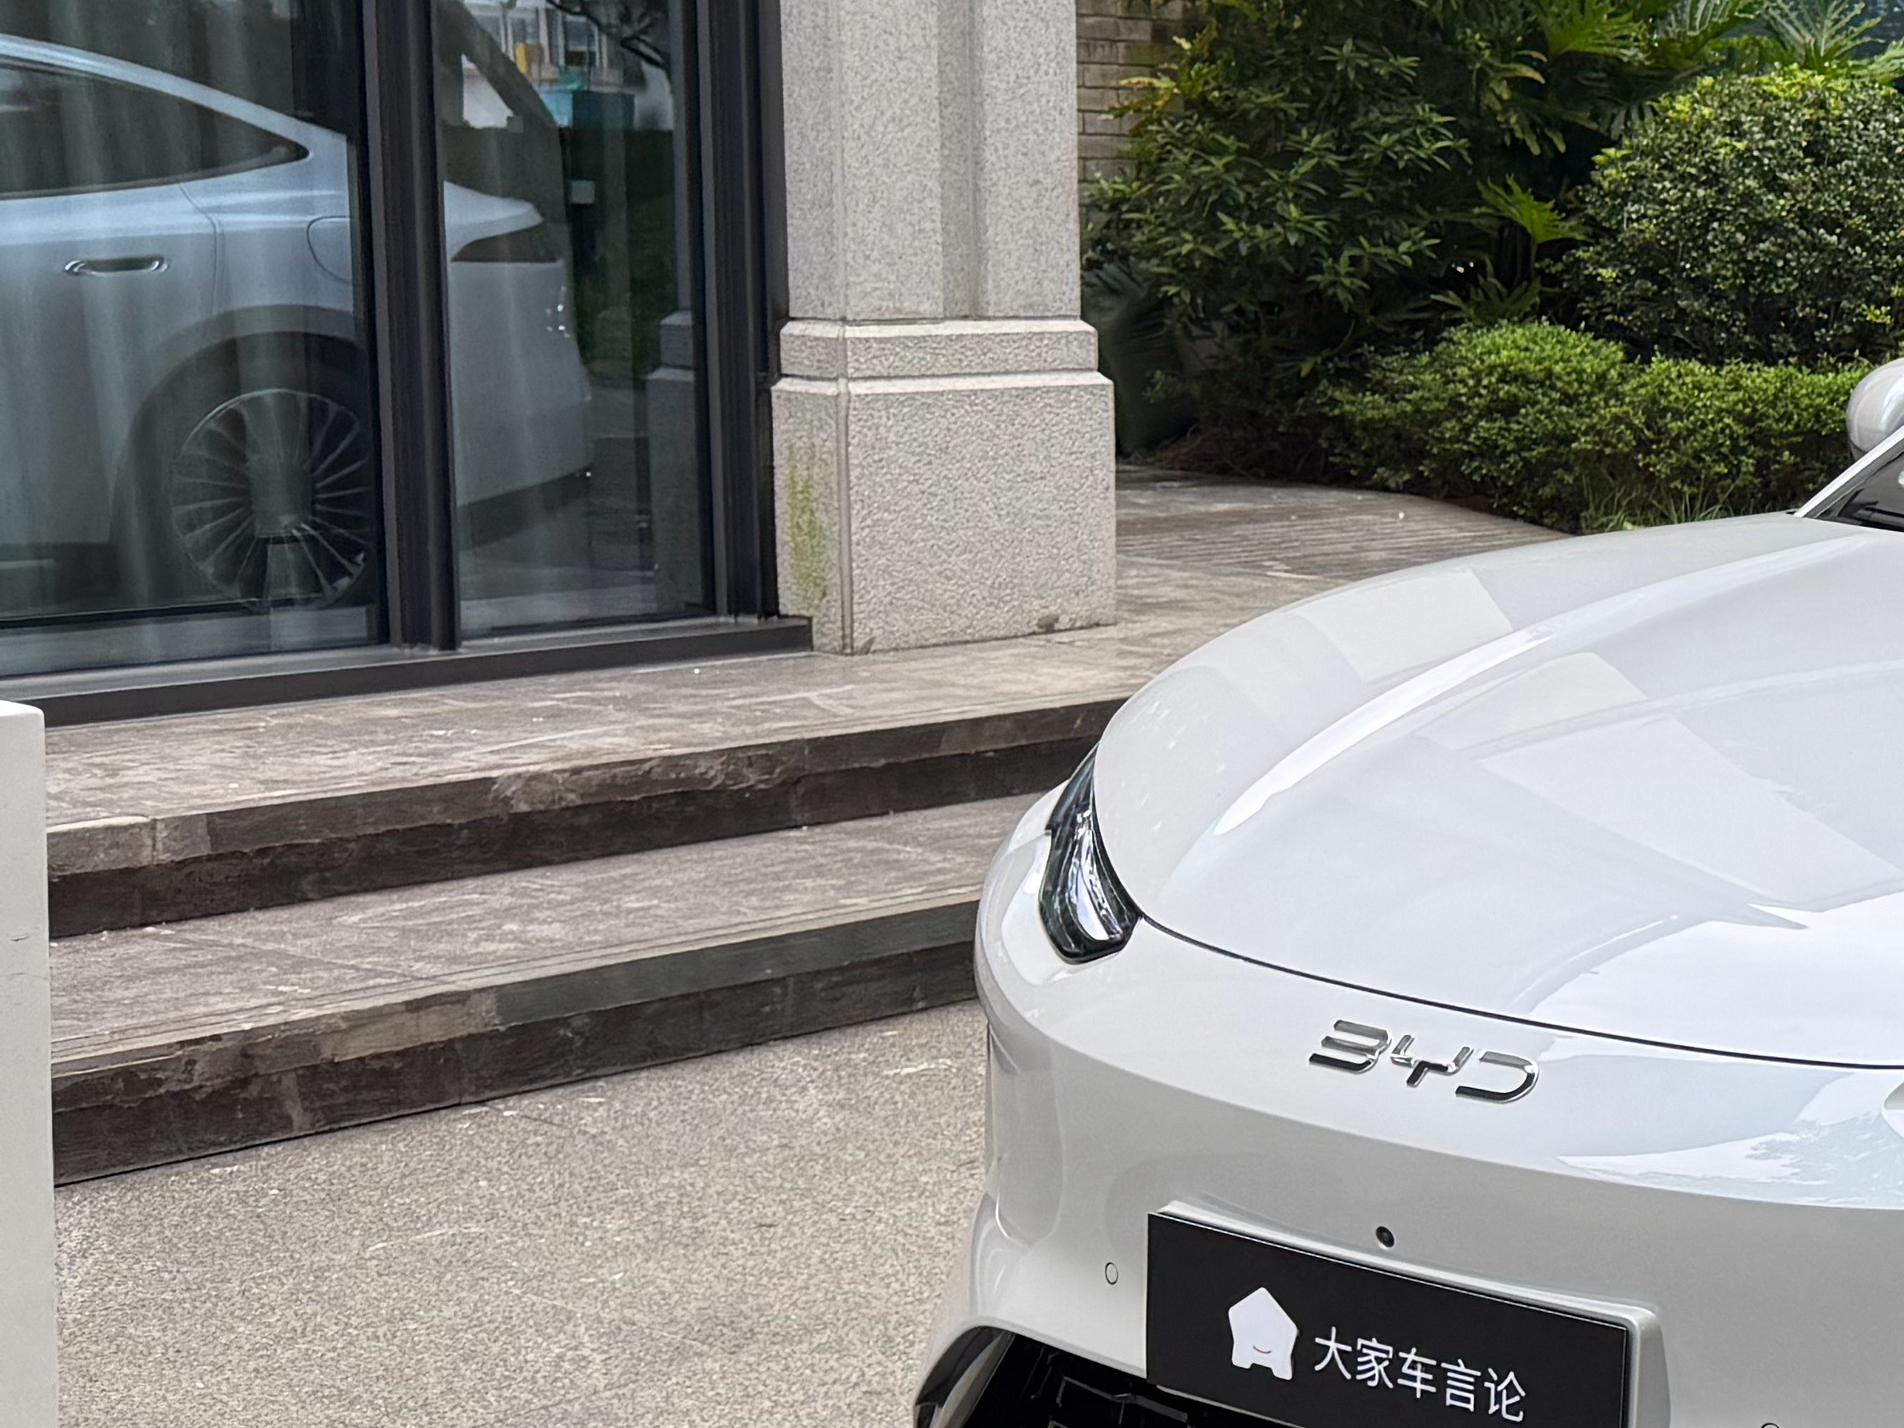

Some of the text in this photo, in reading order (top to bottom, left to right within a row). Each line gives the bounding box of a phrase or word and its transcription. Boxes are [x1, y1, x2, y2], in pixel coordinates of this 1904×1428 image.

[1309, 1019, 1540, 1104] BYD
[1313, 1326, 1527, 1423] 大家车言论
